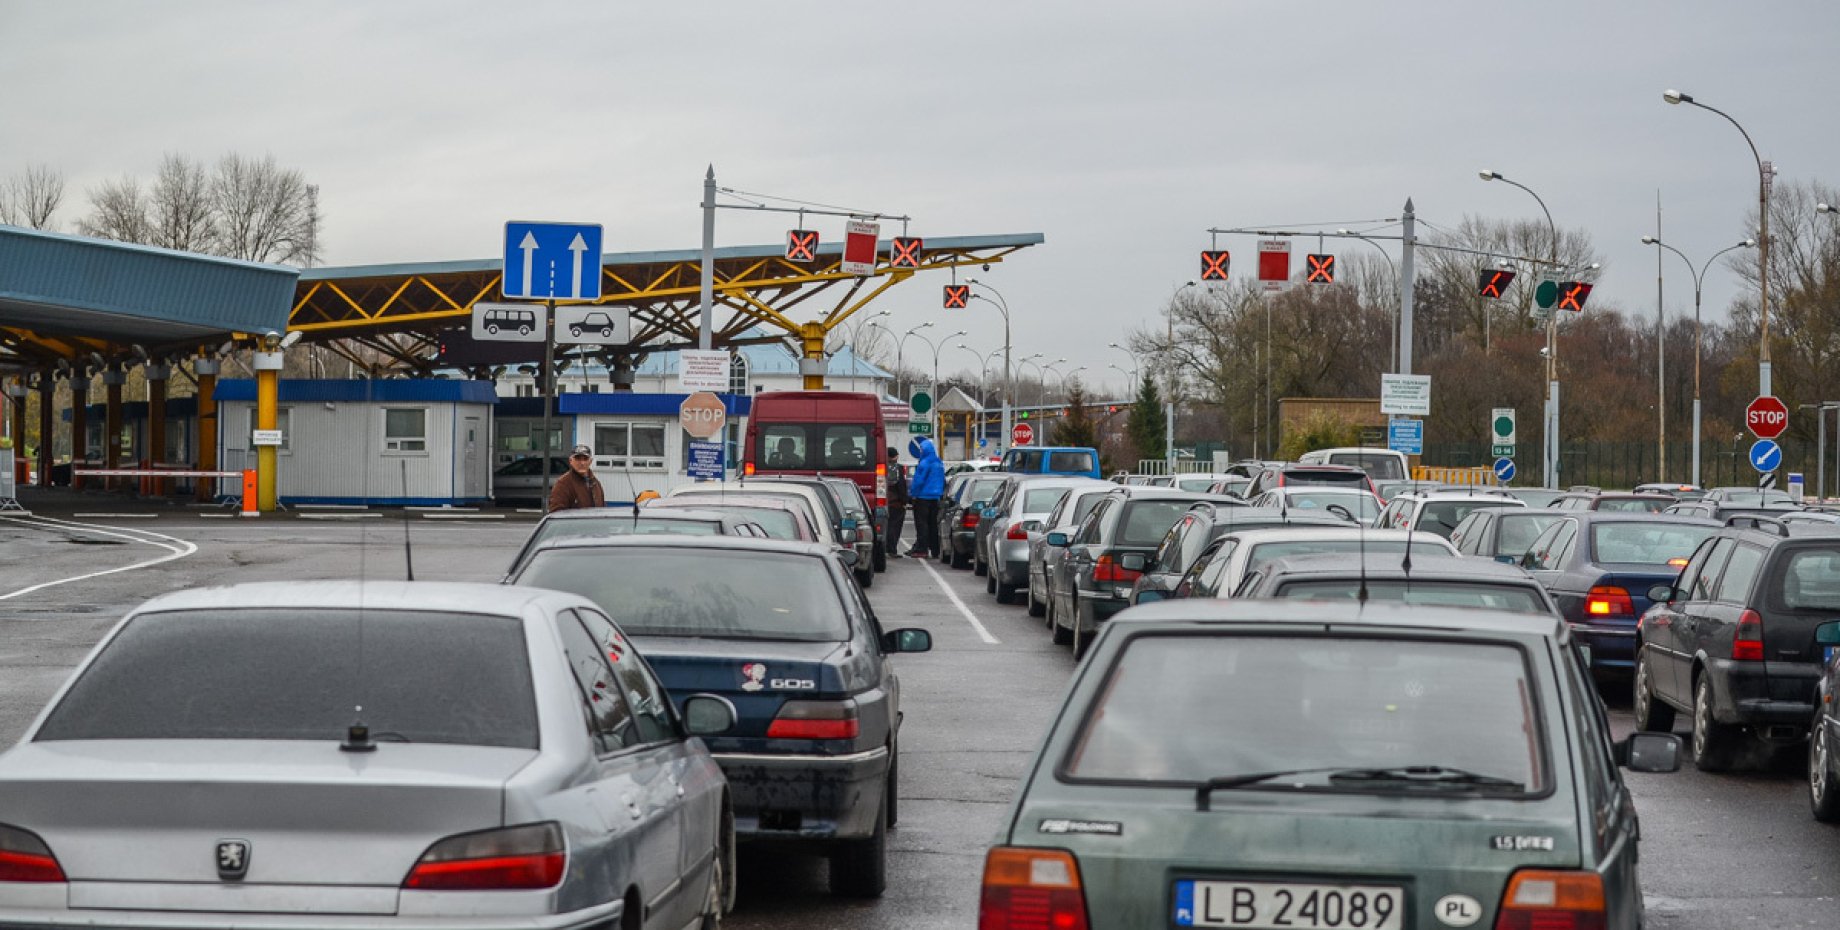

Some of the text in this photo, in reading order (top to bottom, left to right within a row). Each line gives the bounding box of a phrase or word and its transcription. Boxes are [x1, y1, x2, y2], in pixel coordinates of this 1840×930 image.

[683, 408, 723, 423] STOP
[1749, 411, 1786, 425] STOP
[1014, 430, 1032, 439] STOP
[770, 679, 815, 689] 605
[1177, 908, 1191, 920] PL
[1204, 887, 1395, 929] LB 24089
[1445, 901, 1472, 918] PL
